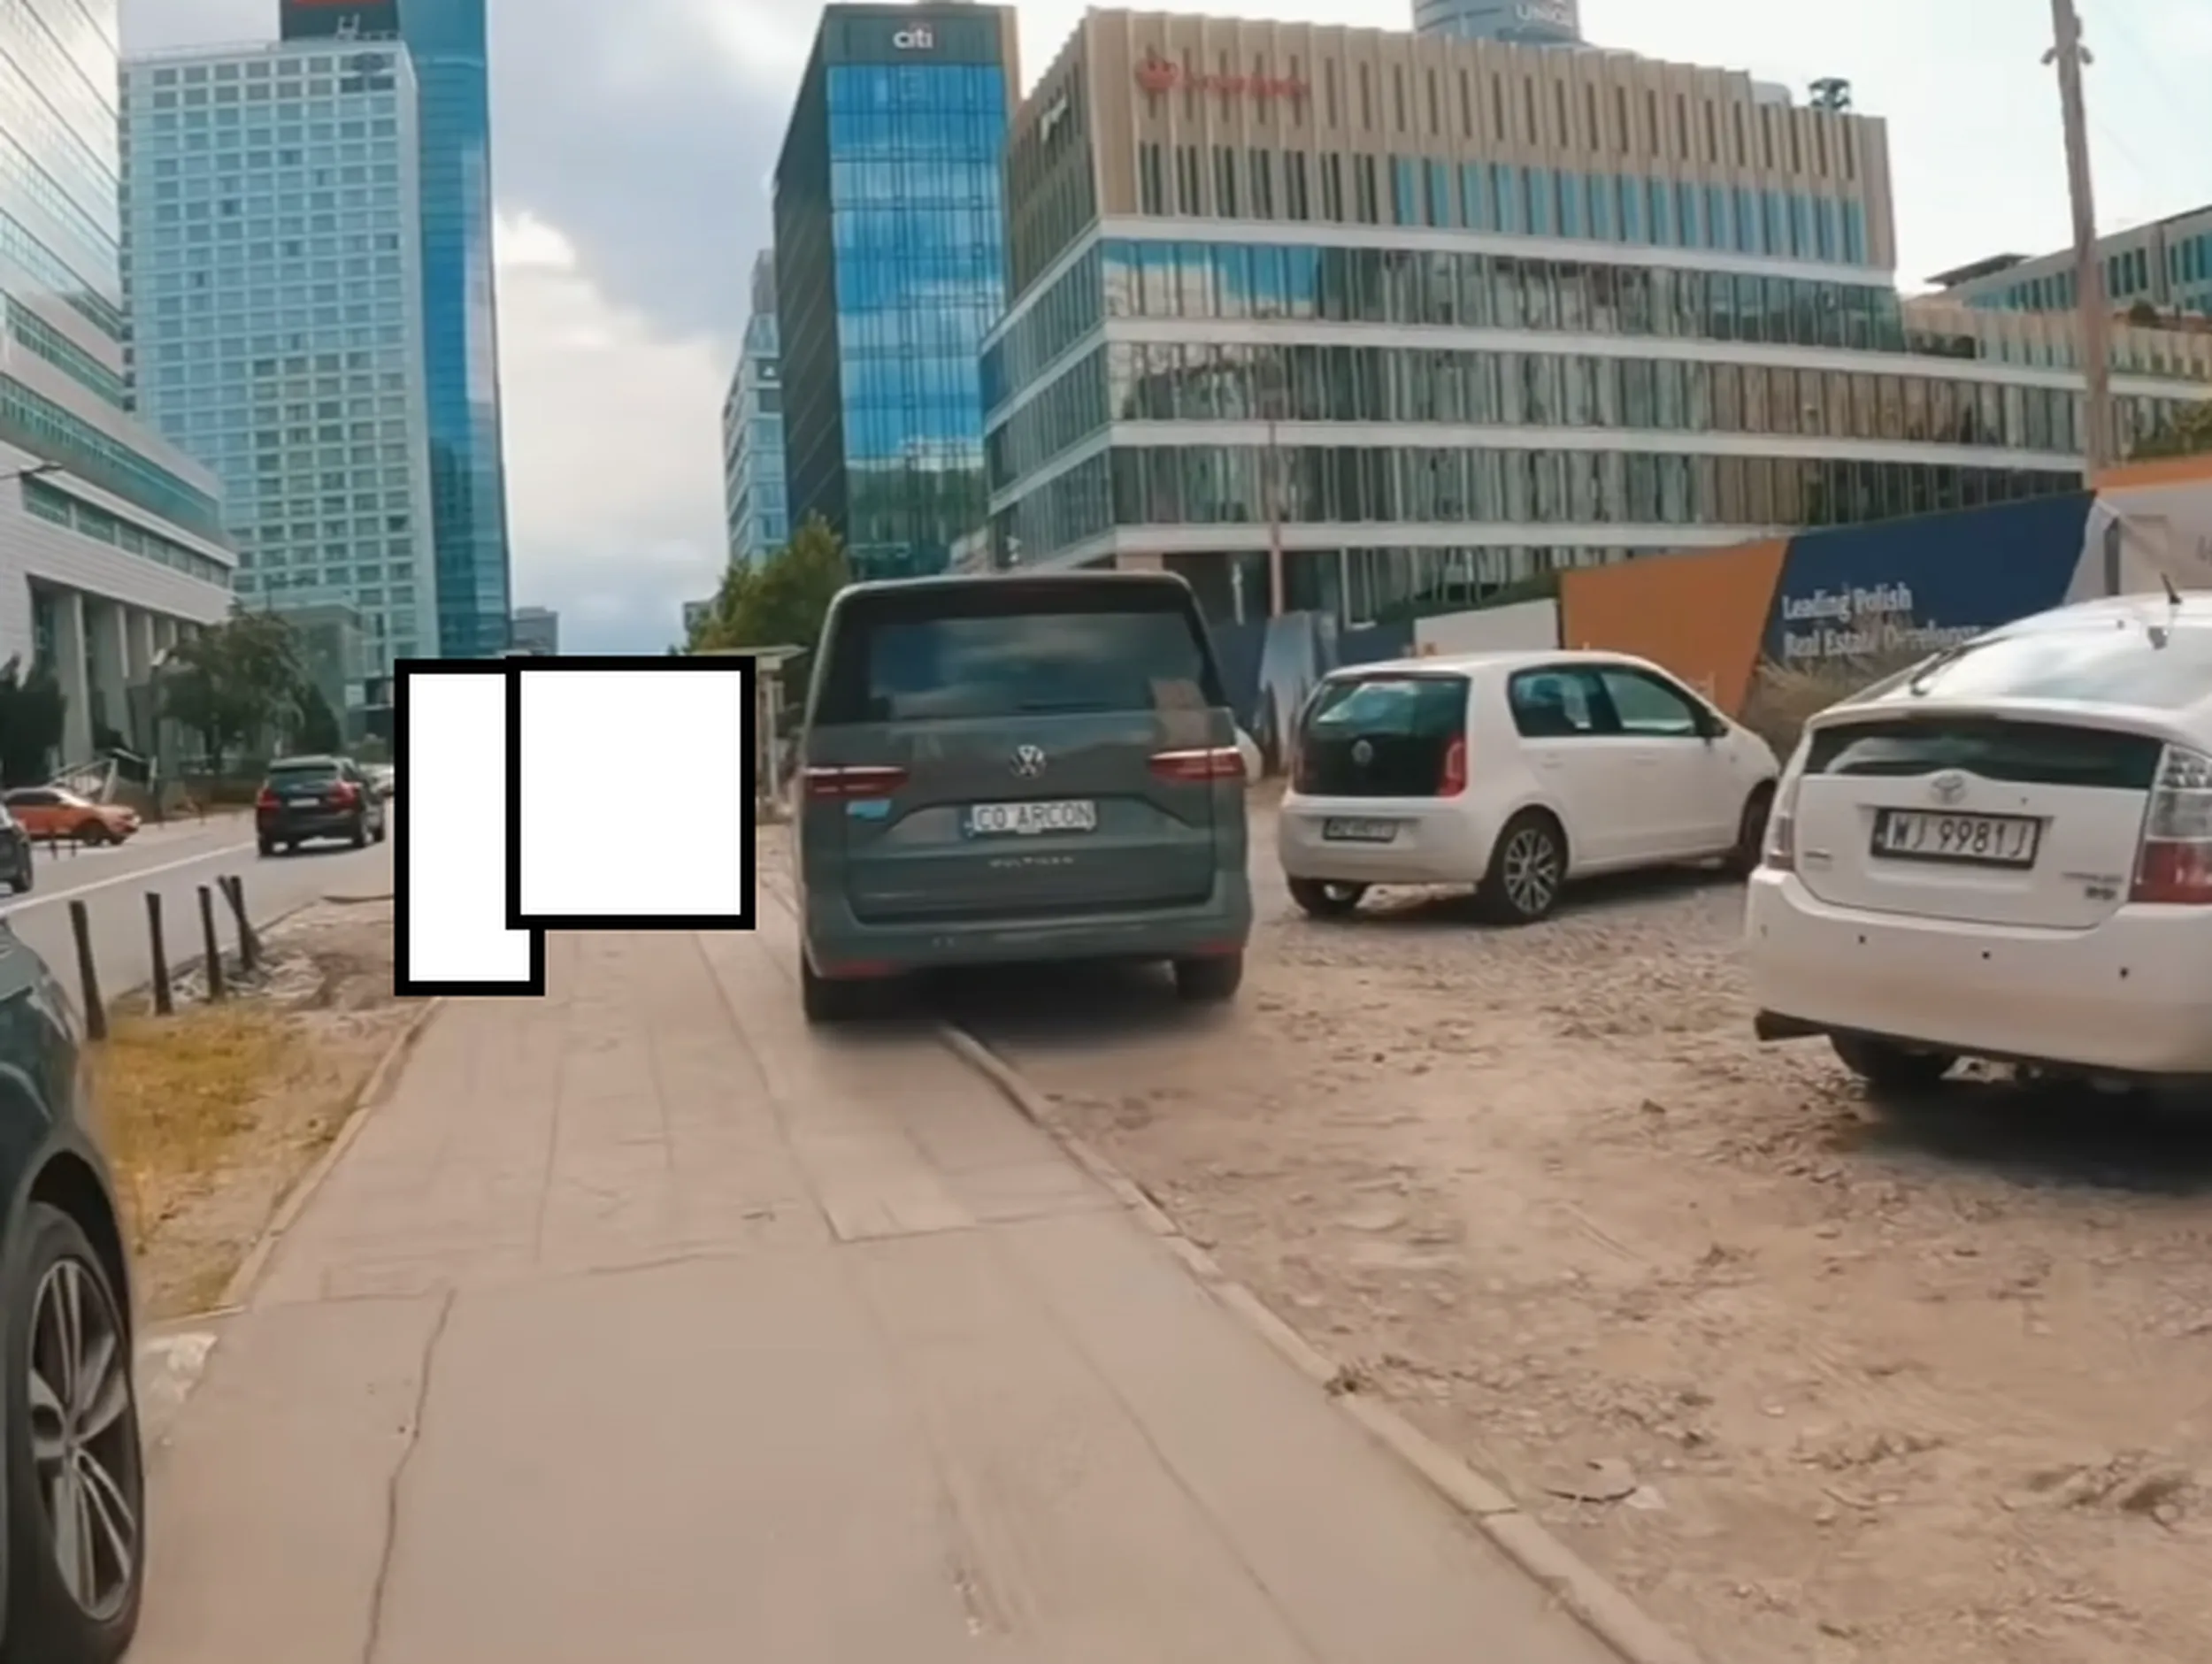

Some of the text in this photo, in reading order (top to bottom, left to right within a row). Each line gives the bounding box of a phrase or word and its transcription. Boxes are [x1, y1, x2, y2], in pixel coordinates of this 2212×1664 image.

[1782, 581, 1913, 622] Leading Polish
[1893, 813, 2029, 859] WJ 9981J
